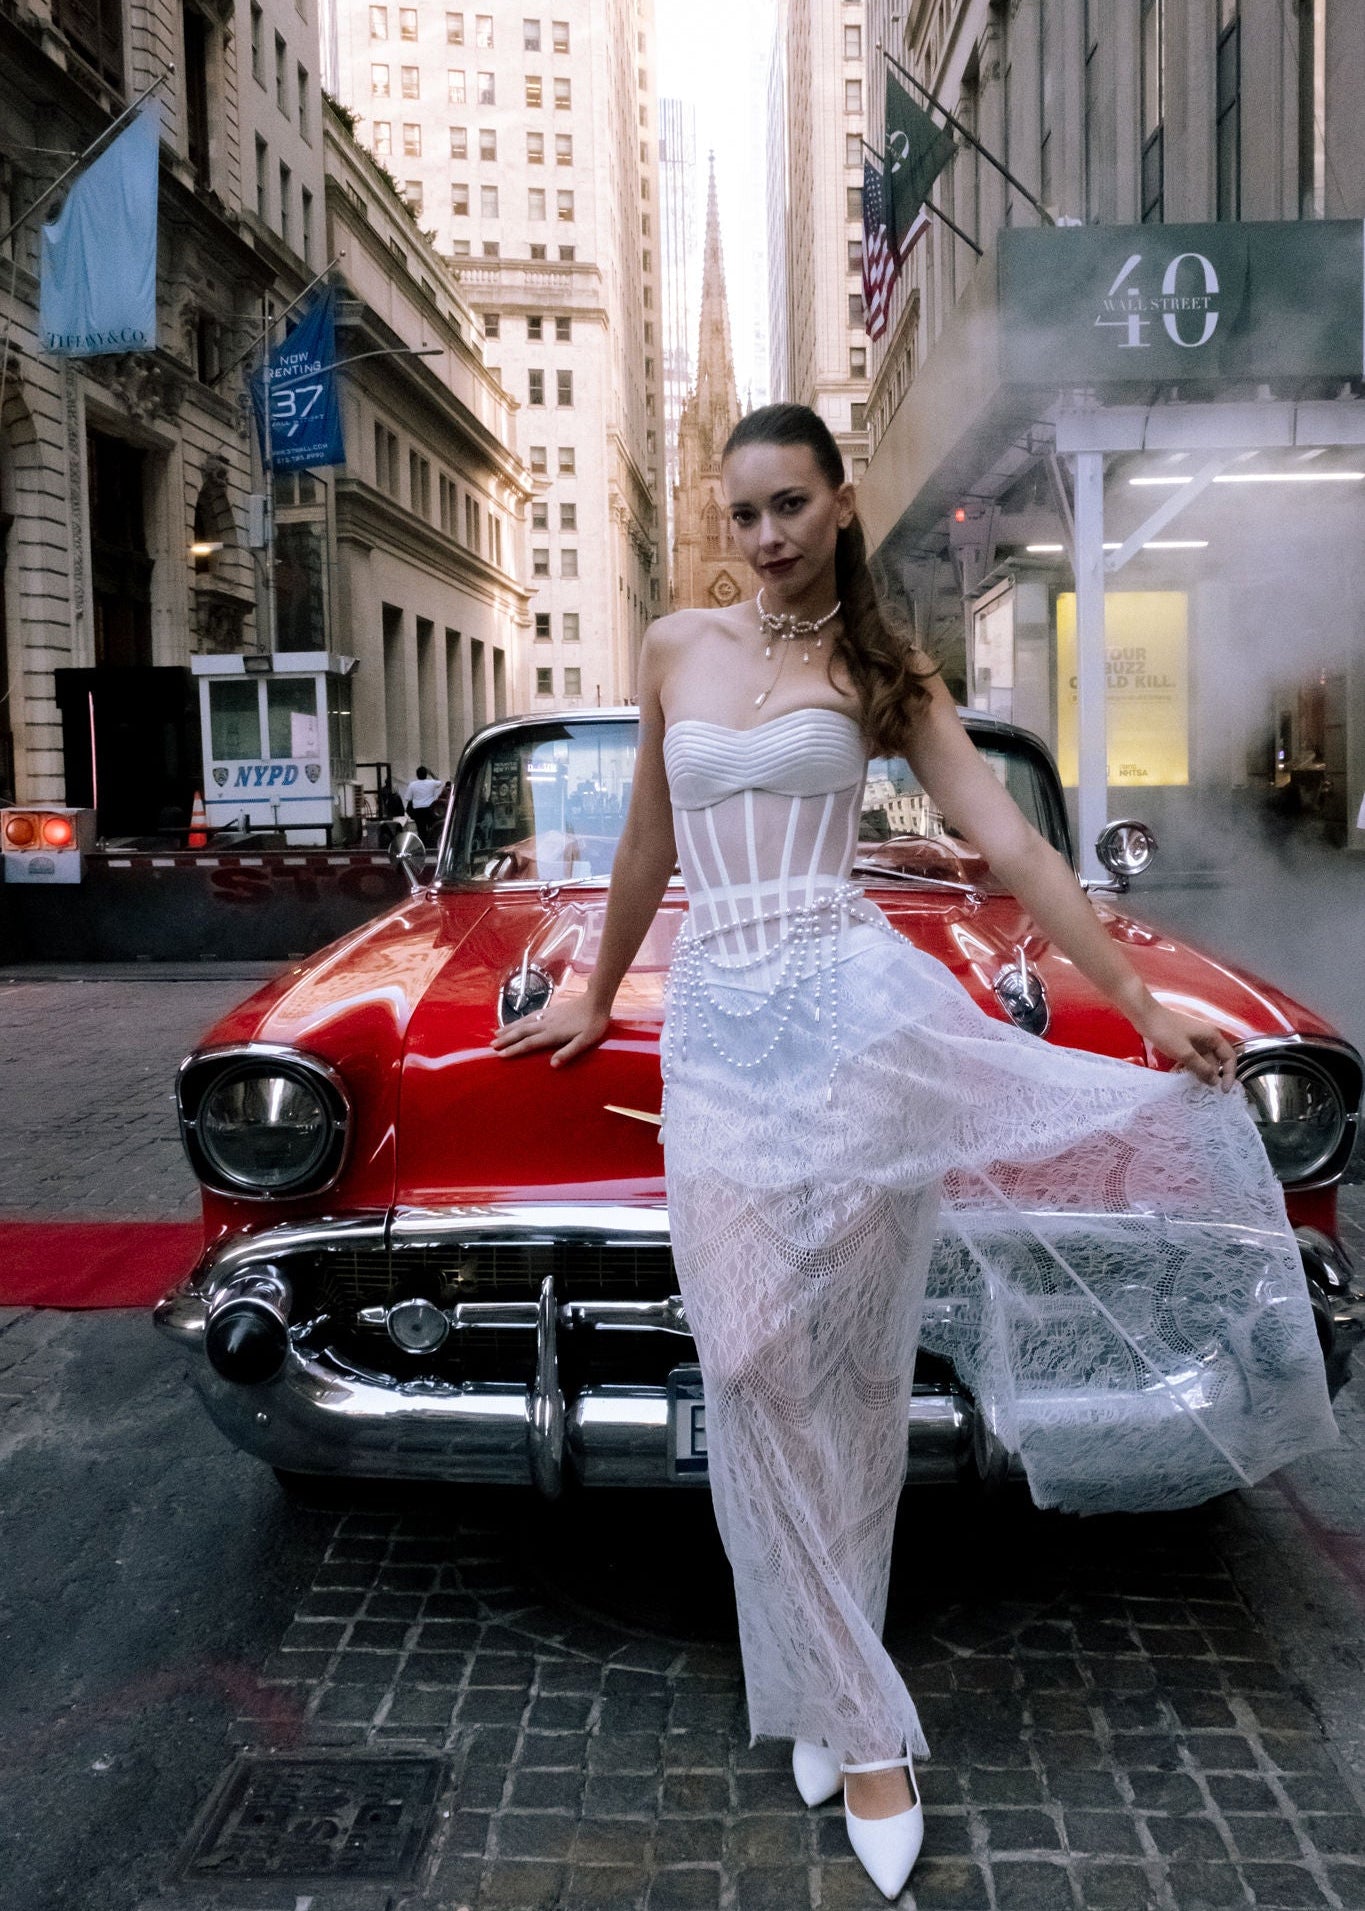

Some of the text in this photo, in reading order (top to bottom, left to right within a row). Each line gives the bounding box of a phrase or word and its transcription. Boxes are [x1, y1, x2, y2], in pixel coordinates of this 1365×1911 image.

[1094, 252, 1219, 348] 40
[1103, 297, 1211, 311] WALL STREET
[280, 352, 309, 366] NOW
[269, 361, 321, 379] RENTING
[272, 385, 323, 437] 37
[1069, 675, 1176, 689] CLD KILL.
[234, 765, 299, 787] NYPD
